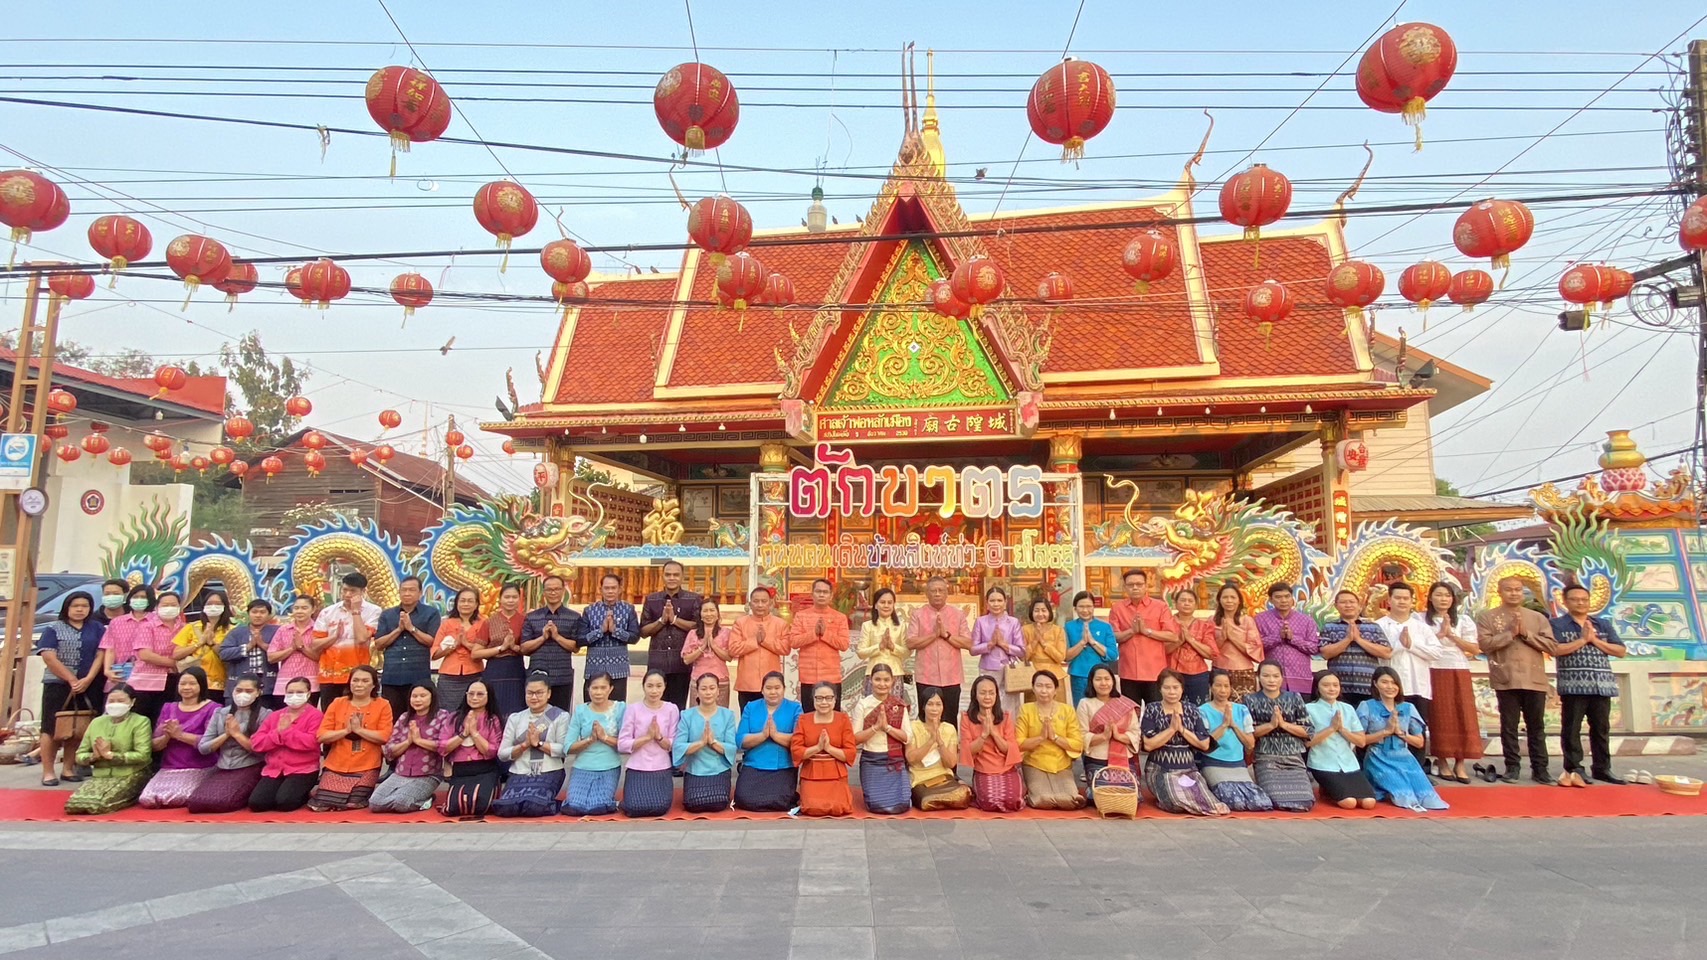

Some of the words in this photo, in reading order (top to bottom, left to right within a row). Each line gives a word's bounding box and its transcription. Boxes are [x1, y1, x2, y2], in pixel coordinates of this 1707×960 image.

[789, 443, 1044, 518] ตักบาตร
[760, 532, 977, 569] ถนนคนเดินบ้านสิงห์ท่า
[985, 540, 1004, 568] @
[1013, 529, 1075, 569] ยโสธร
